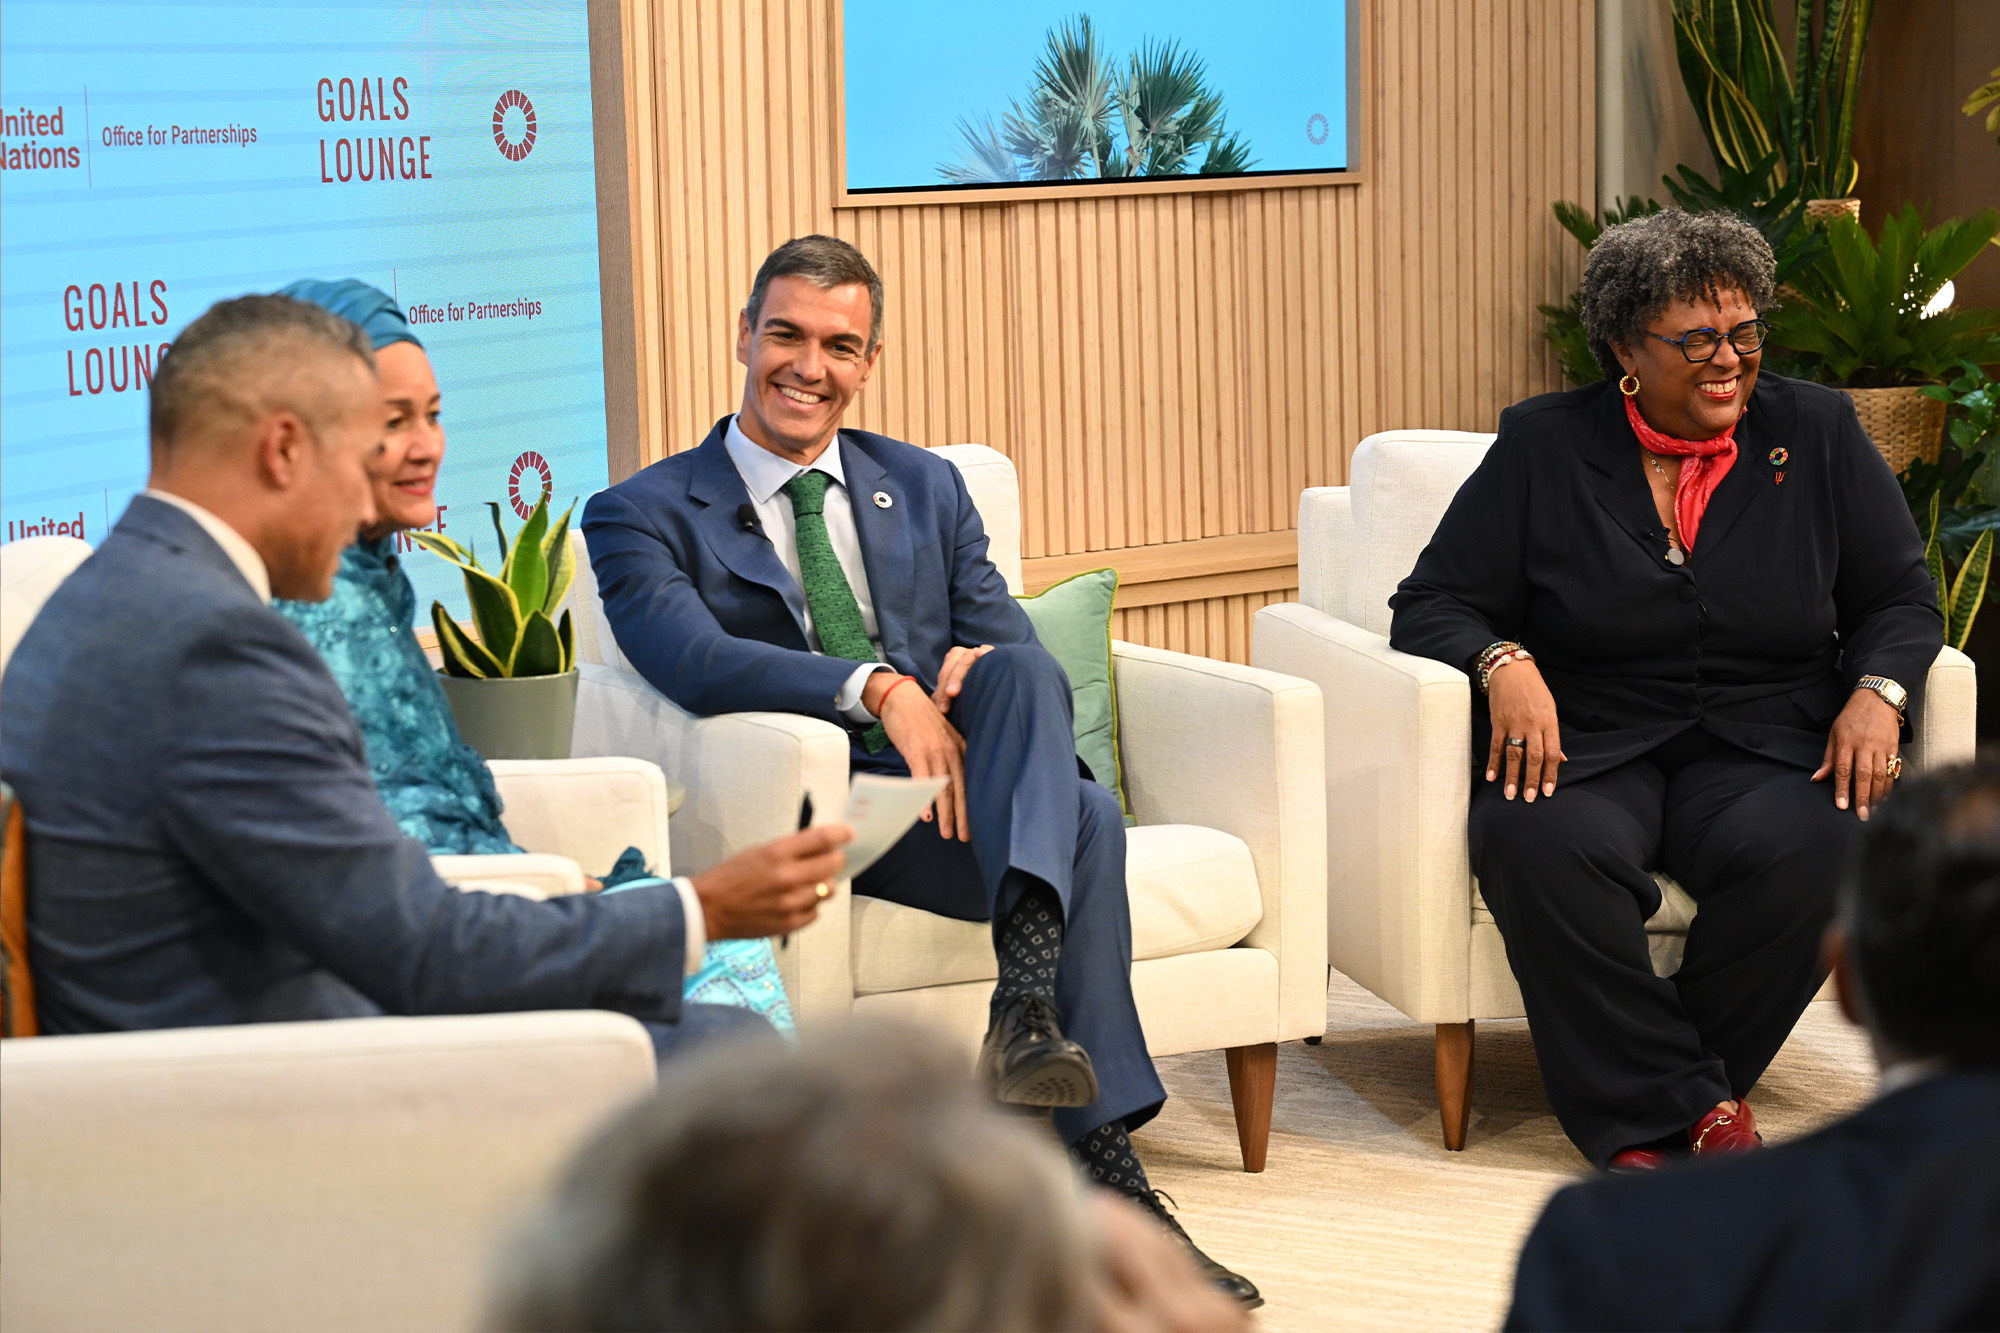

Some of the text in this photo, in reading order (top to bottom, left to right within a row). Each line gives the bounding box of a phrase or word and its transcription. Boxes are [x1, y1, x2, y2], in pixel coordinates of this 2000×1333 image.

[317, 76, 409, 122] GOALS
[0, 106, 64, 136] nited
[102, 123, 258, 148] Office for Partnerships
[320, 136, 433, 183] LOUNGE
[64, 279, 168, 332] GOALS
[409, 297, 542, 325] Office for Partnerships
